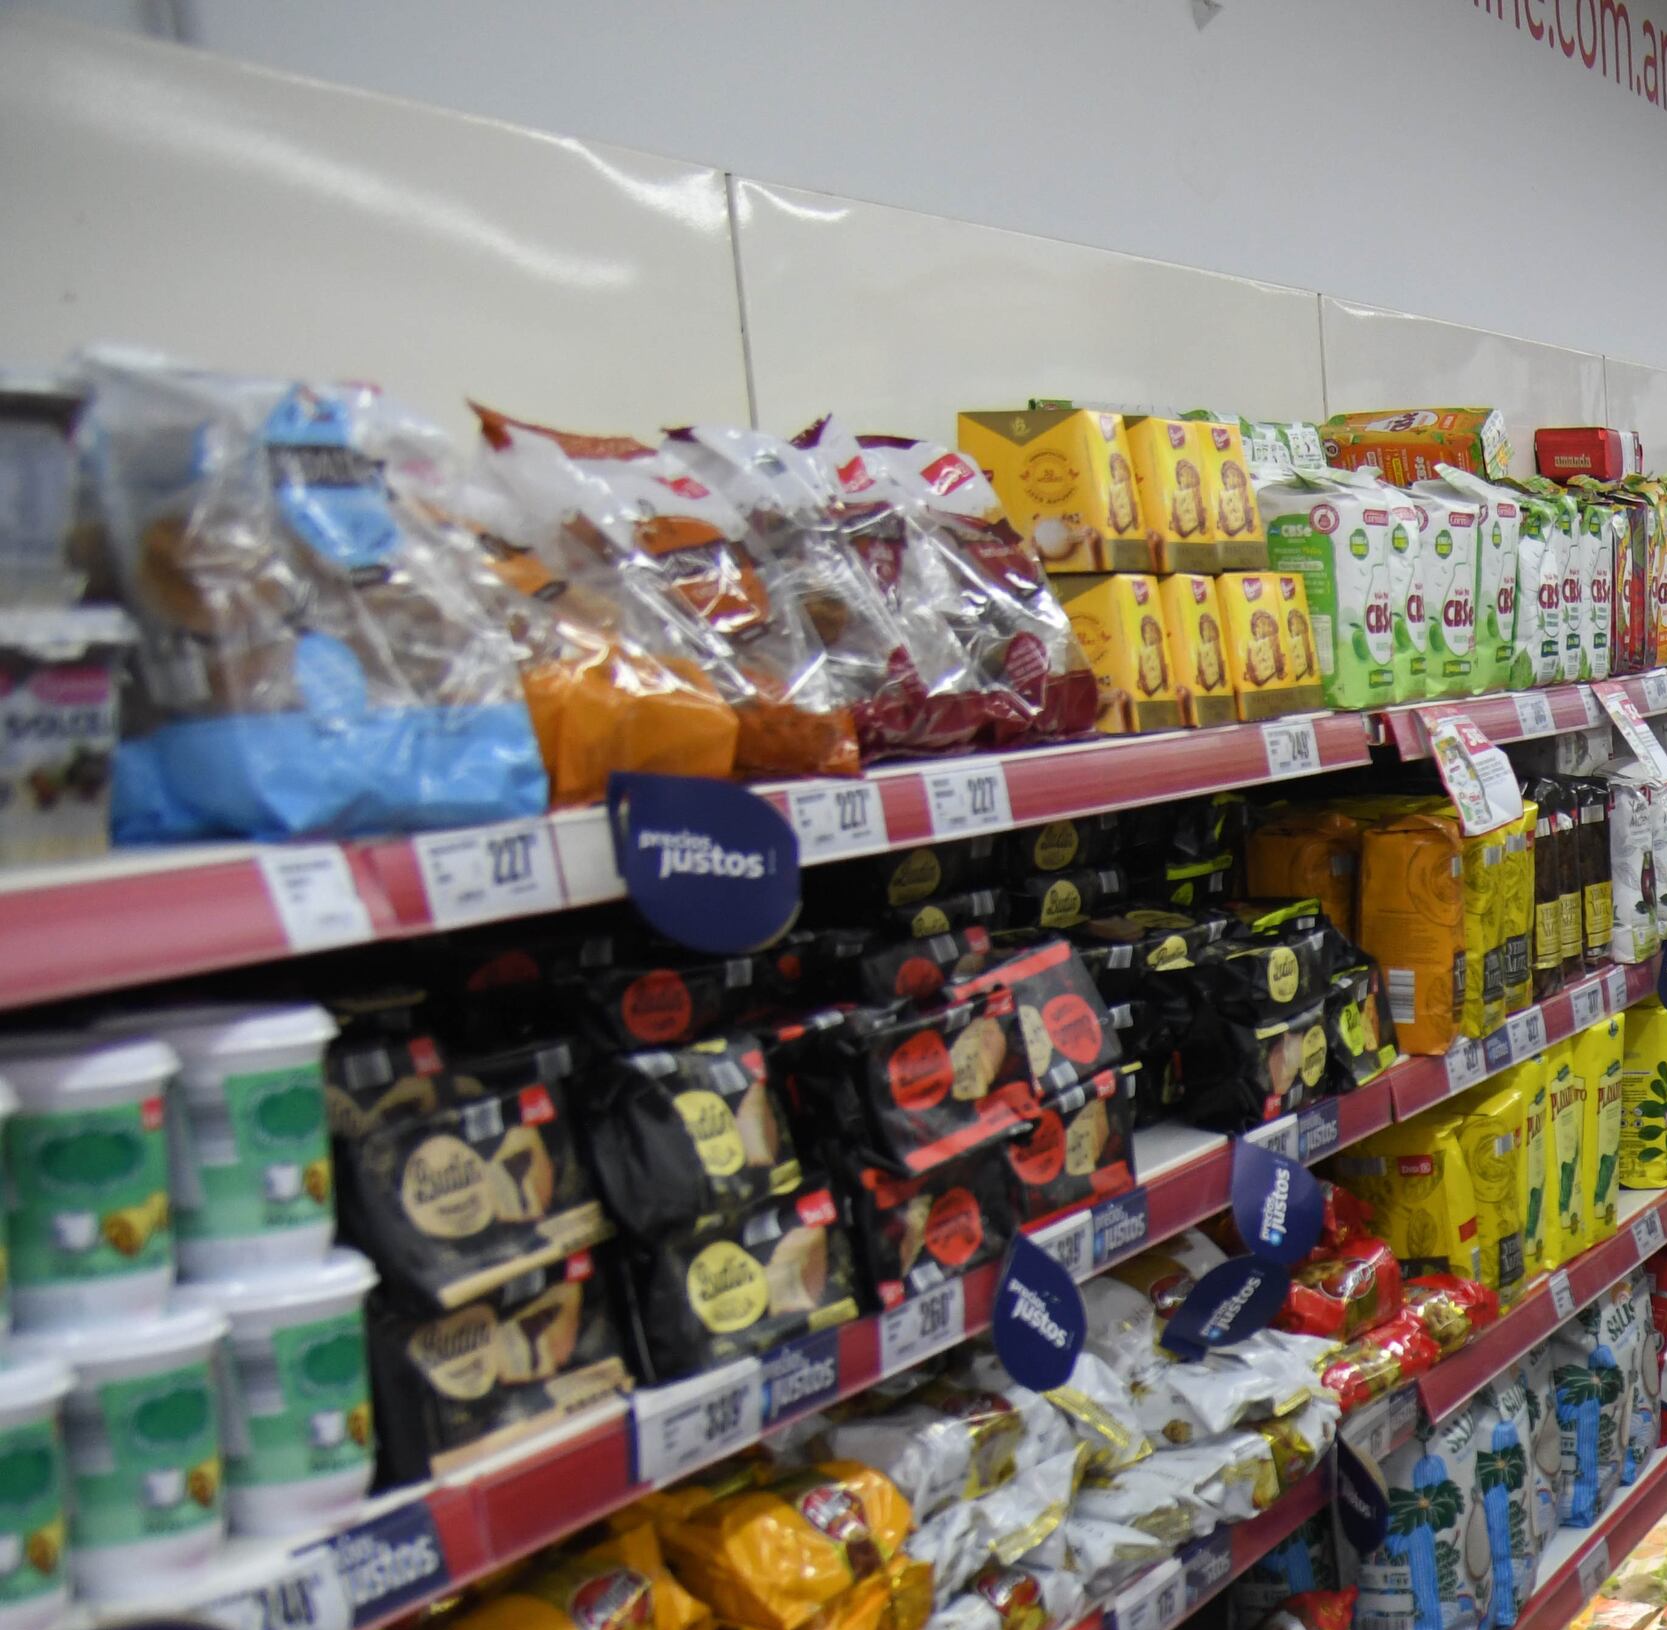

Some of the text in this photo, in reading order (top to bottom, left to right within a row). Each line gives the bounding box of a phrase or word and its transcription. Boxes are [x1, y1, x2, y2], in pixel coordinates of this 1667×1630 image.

[639, 827, 712, 850] precios
[659, 847, 765, 880] justos
[1270, 1167, 1291, 1234] justos
[1011, 1294, 1069, 1350] justos
[1217, 1275, 1263, 1331] justos
